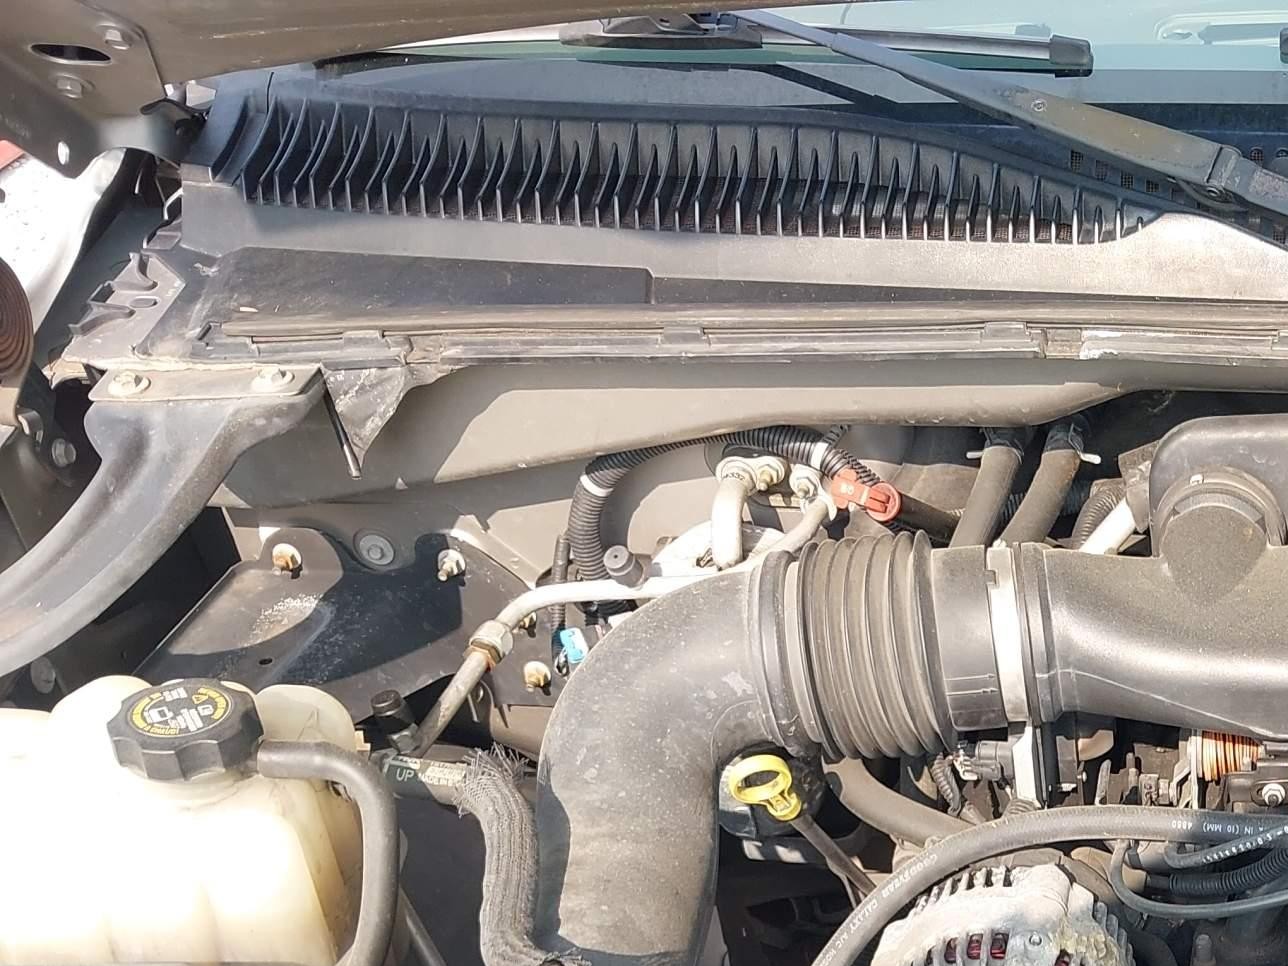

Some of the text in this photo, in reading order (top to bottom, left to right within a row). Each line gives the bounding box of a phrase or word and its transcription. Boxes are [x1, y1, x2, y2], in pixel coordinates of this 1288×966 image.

[396, 768, 415, 782] UP
[881, 853, 938, 899] GOODYEAR
[849, 899, 879, 934] GALAXY
[835, 932, 849, 949] A/C
